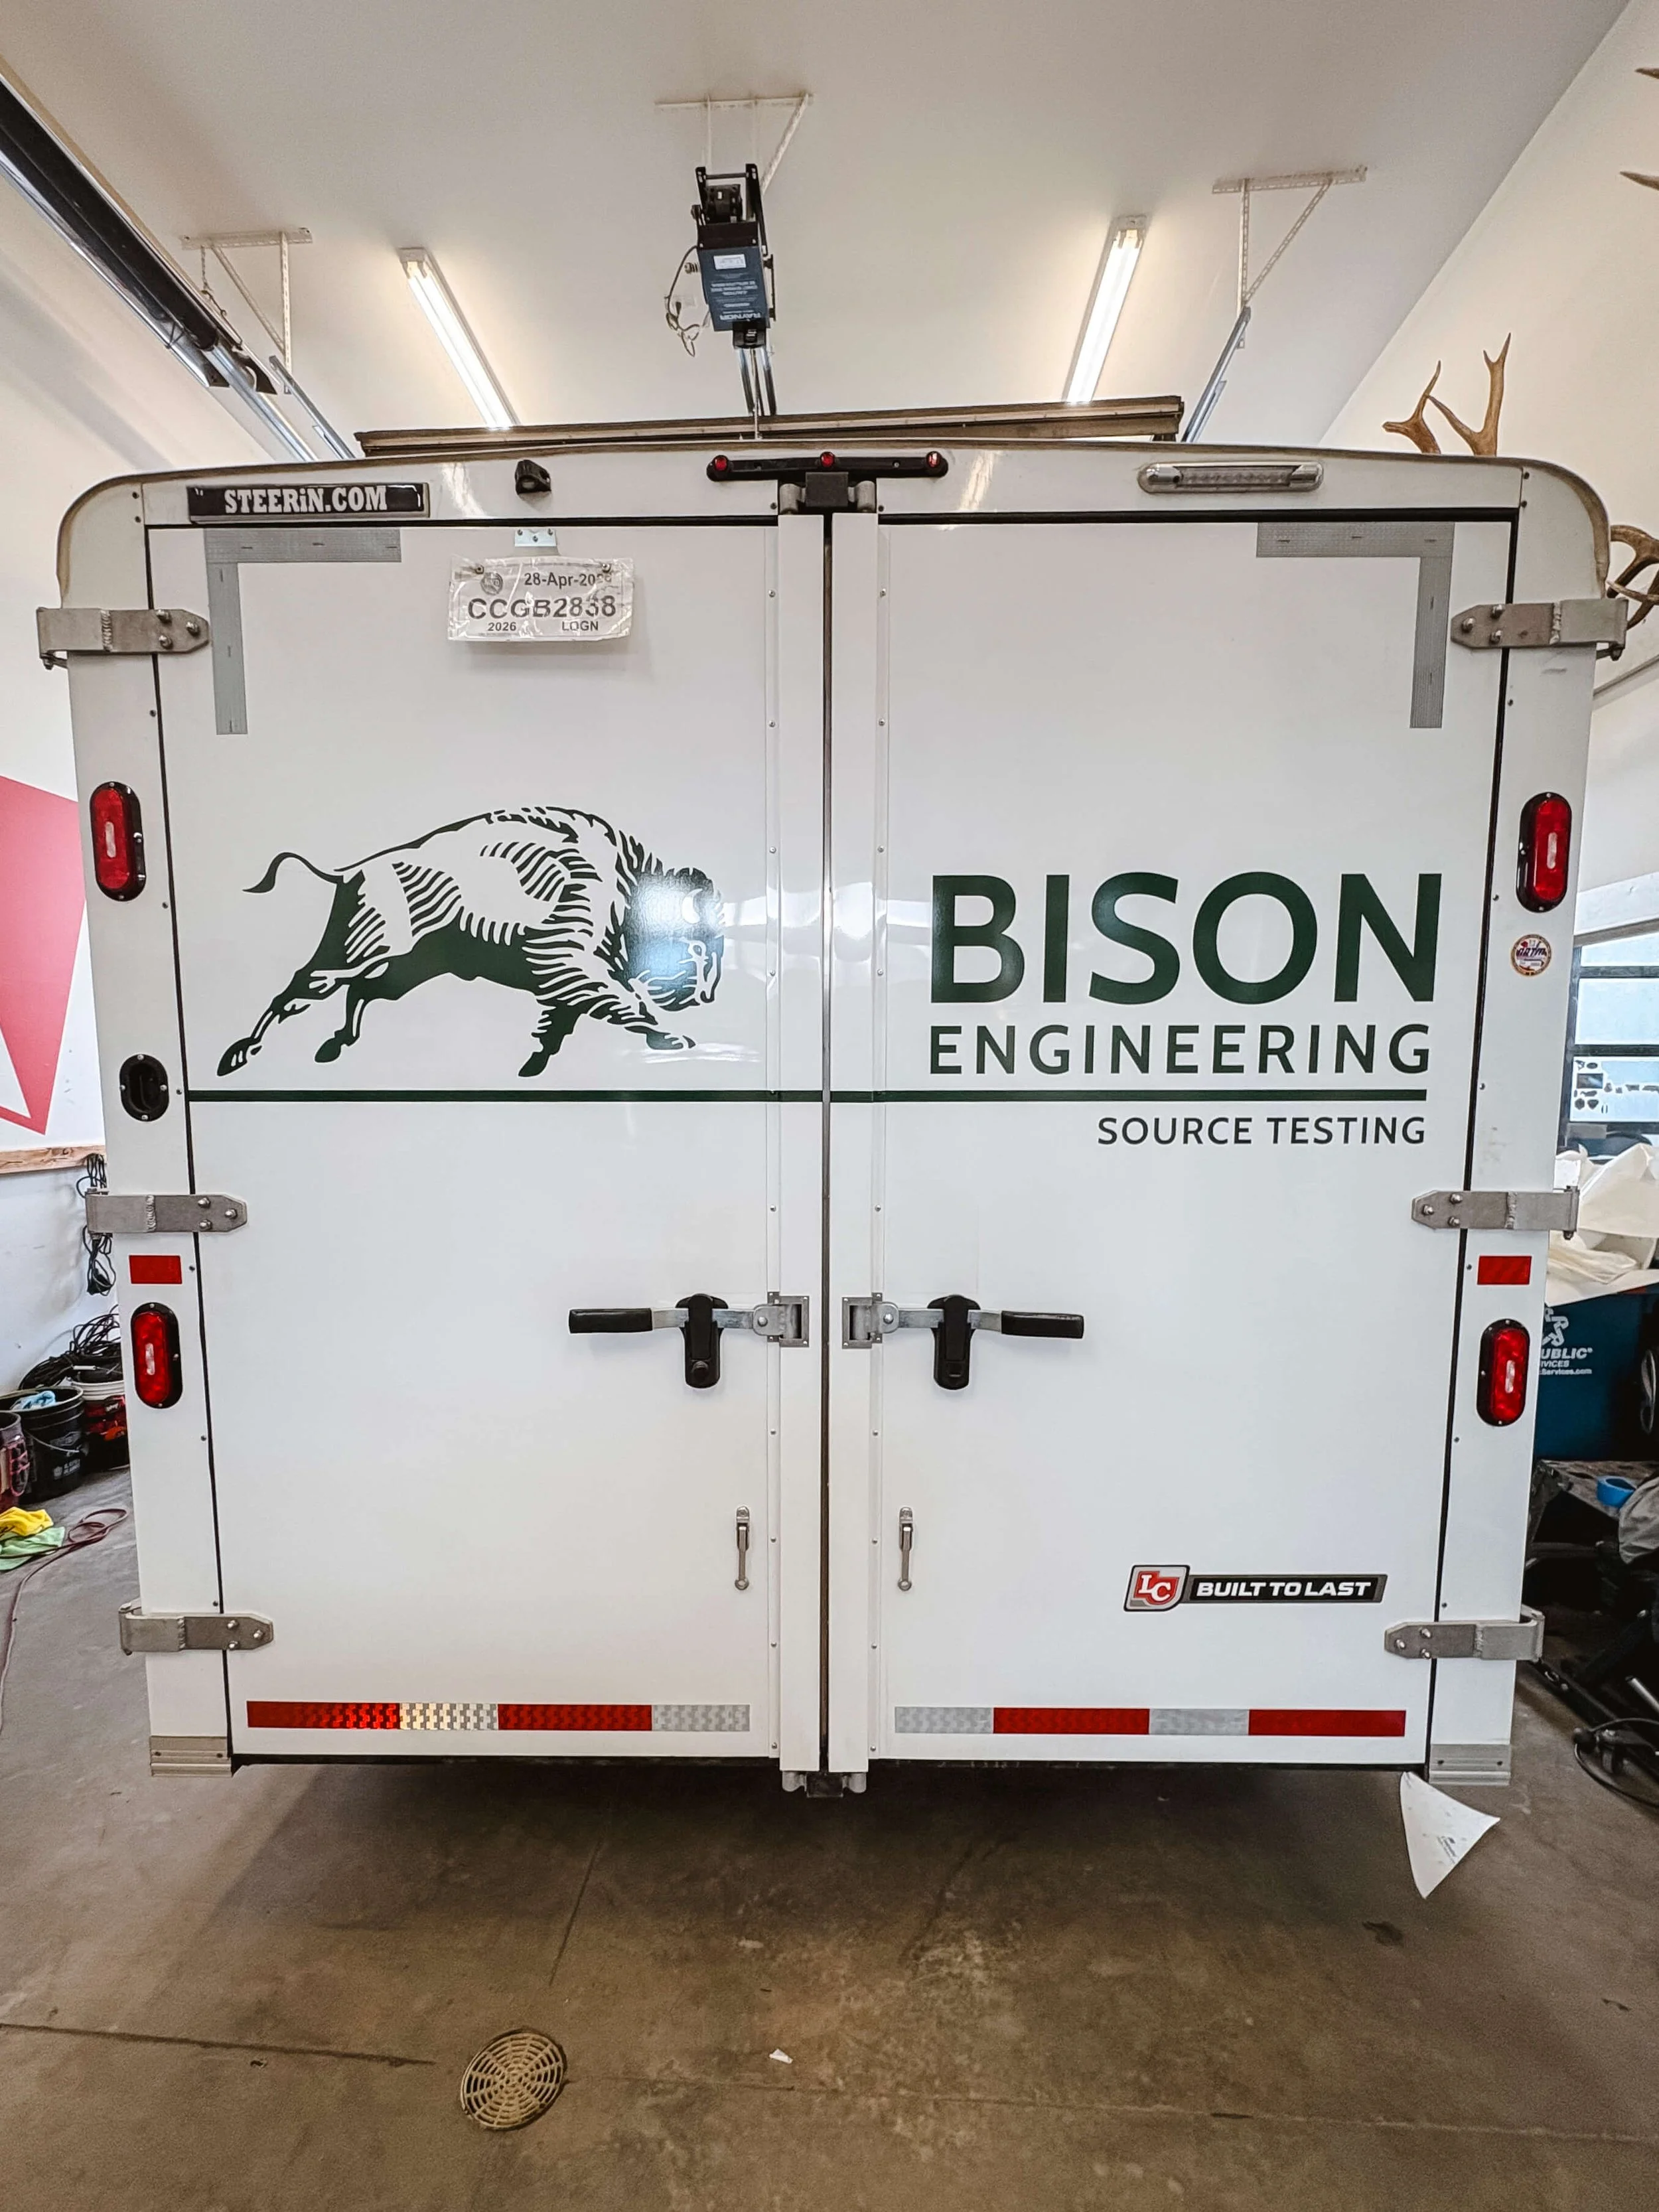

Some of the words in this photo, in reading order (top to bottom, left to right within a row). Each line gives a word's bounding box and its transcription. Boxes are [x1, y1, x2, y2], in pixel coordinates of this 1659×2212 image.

[487, 621, 517, 632] 2026
[561, 621, 599, 631] LOGN
[930, 871, 1442, 1005] BISON
[930, 1023, 1430, 1074] ENGINEERING
[1098, 1116, 1253, 1145] SOURCE
[1266, 1116, 1425, 1145] TESTING
[1196, 1582, 1267, 1597] BUILT
[1269, 1582, 1303, 1597] TO
[1304, 1581, 1372, 1597] LAST
